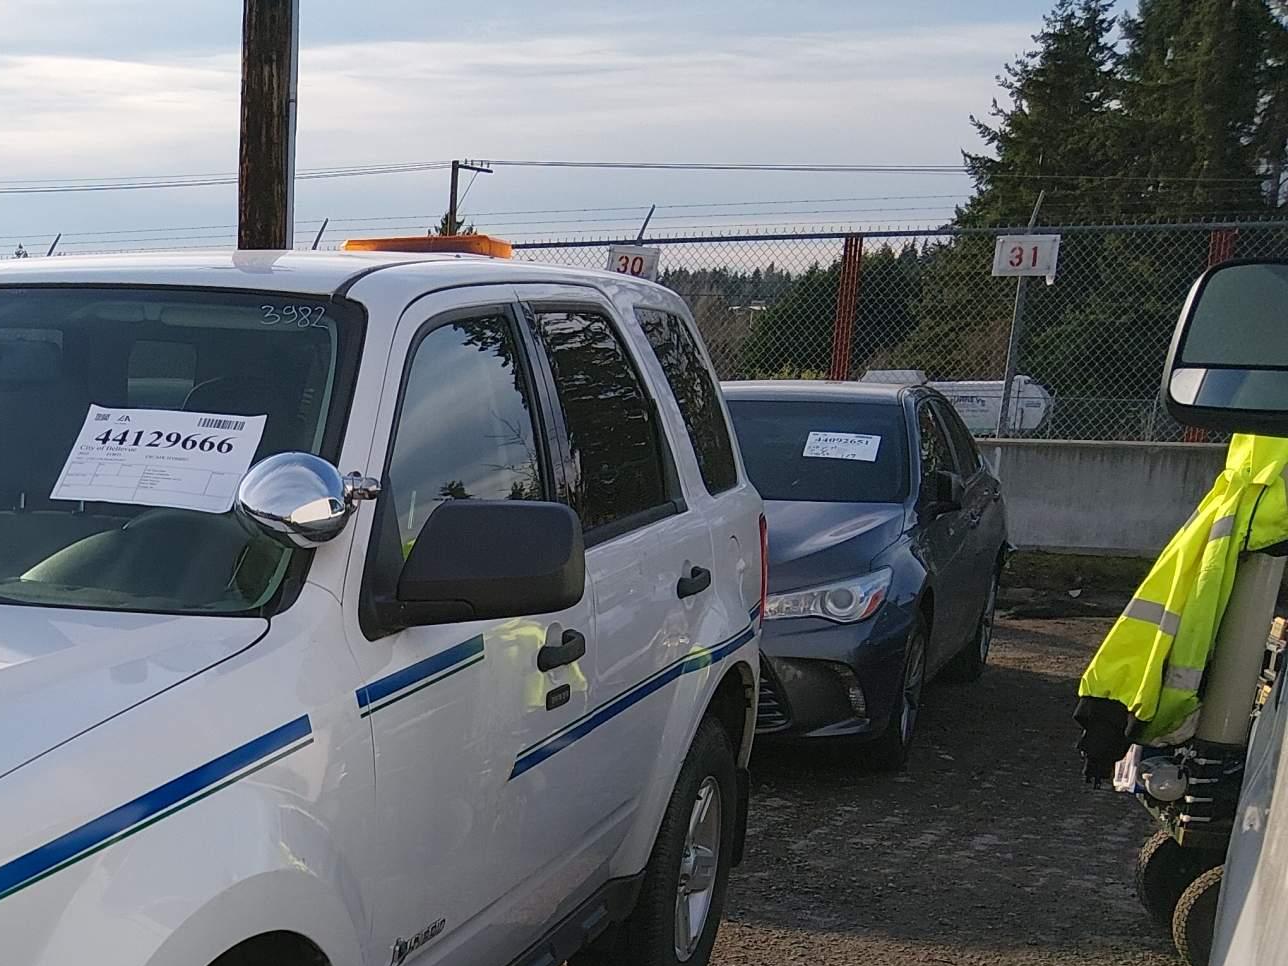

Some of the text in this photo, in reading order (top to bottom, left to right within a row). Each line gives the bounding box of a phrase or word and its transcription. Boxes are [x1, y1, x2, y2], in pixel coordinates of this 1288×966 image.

[617, 255, 643, 276] 30
[1009, 246, 1038, 267] 31
[260, 305, 329, 330] 3982
[94, 428, 239, 454] 44129666
